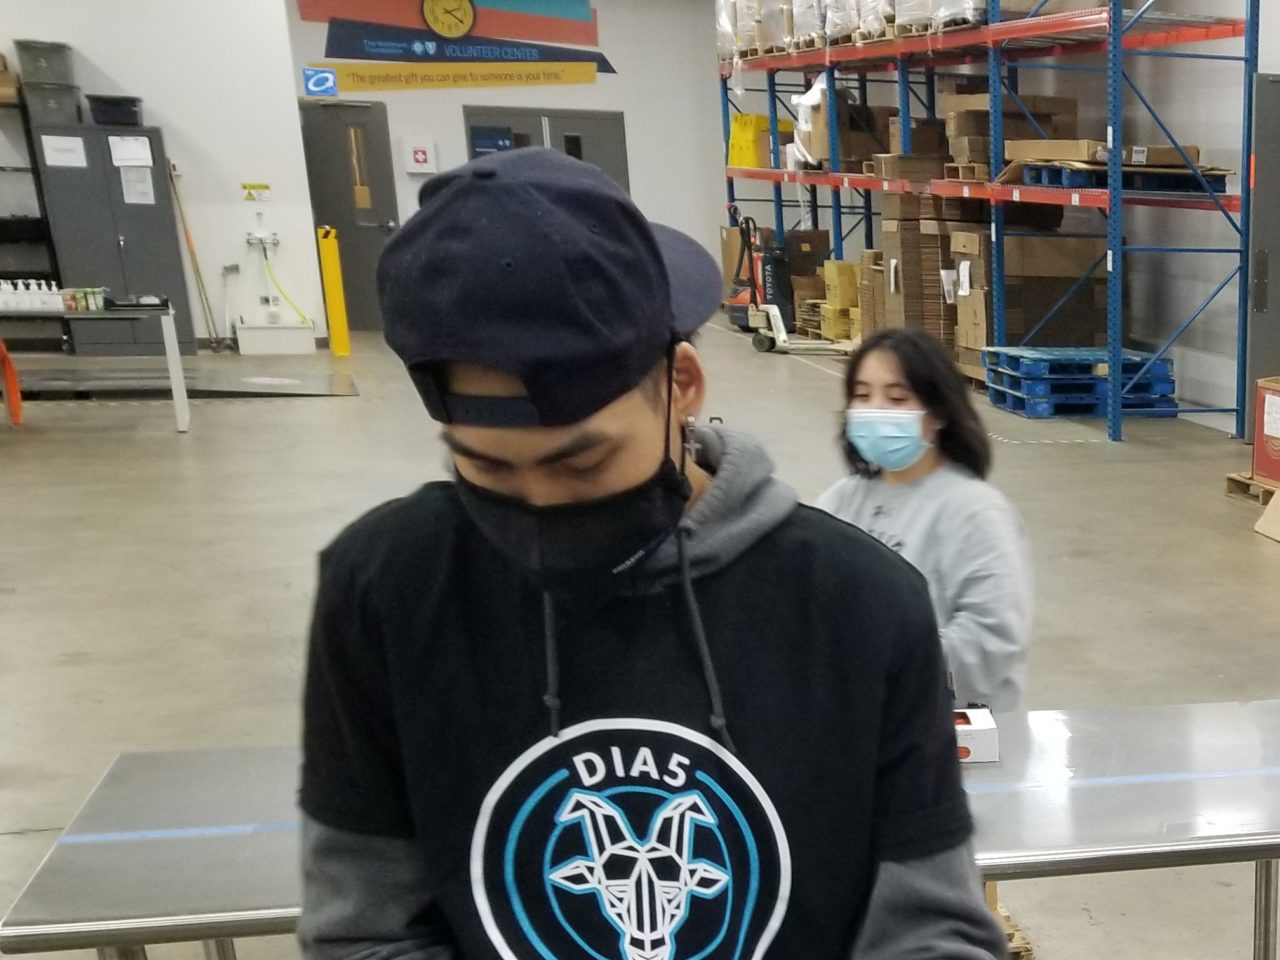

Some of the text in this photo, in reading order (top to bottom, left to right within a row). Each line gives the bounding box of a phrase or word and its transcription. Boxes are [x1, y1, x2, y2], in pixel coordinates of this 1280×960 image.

[443, 44, 538, 60] VOLUNTEER CENTER
[764, 264, 774, 300] TOYOTA
[571, 745, 692, 788] DIA5
